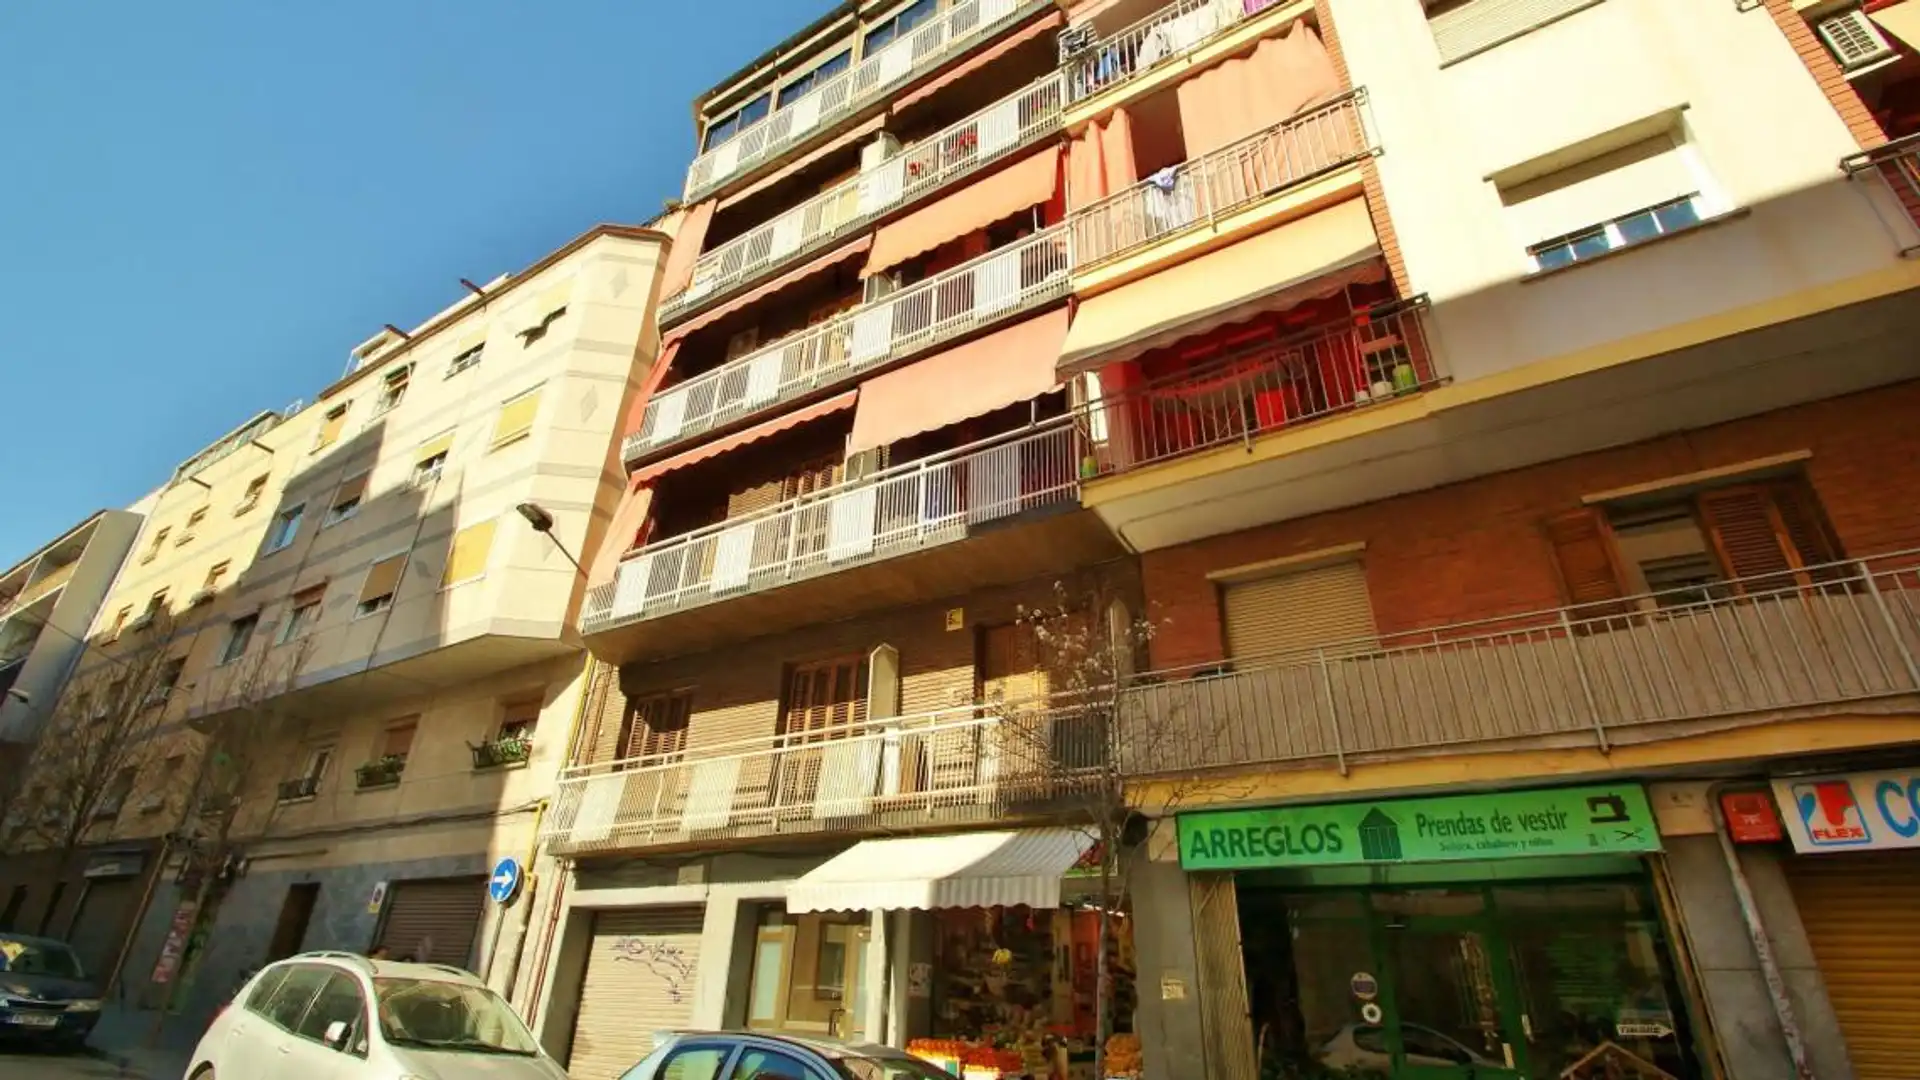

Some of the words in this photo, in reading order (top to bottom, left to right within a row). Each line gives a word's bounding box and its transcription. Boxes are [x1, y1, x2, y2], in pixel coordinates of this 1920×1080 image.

[1415, 810, 1486, 837] Prendas
[1489, 806, 1512, 834] de
[1517, 804, 1567, 832] vestir
[1812, 827, 1865, 839] FLEX
[1190, 822, 1343, 860] ARREGLOS
